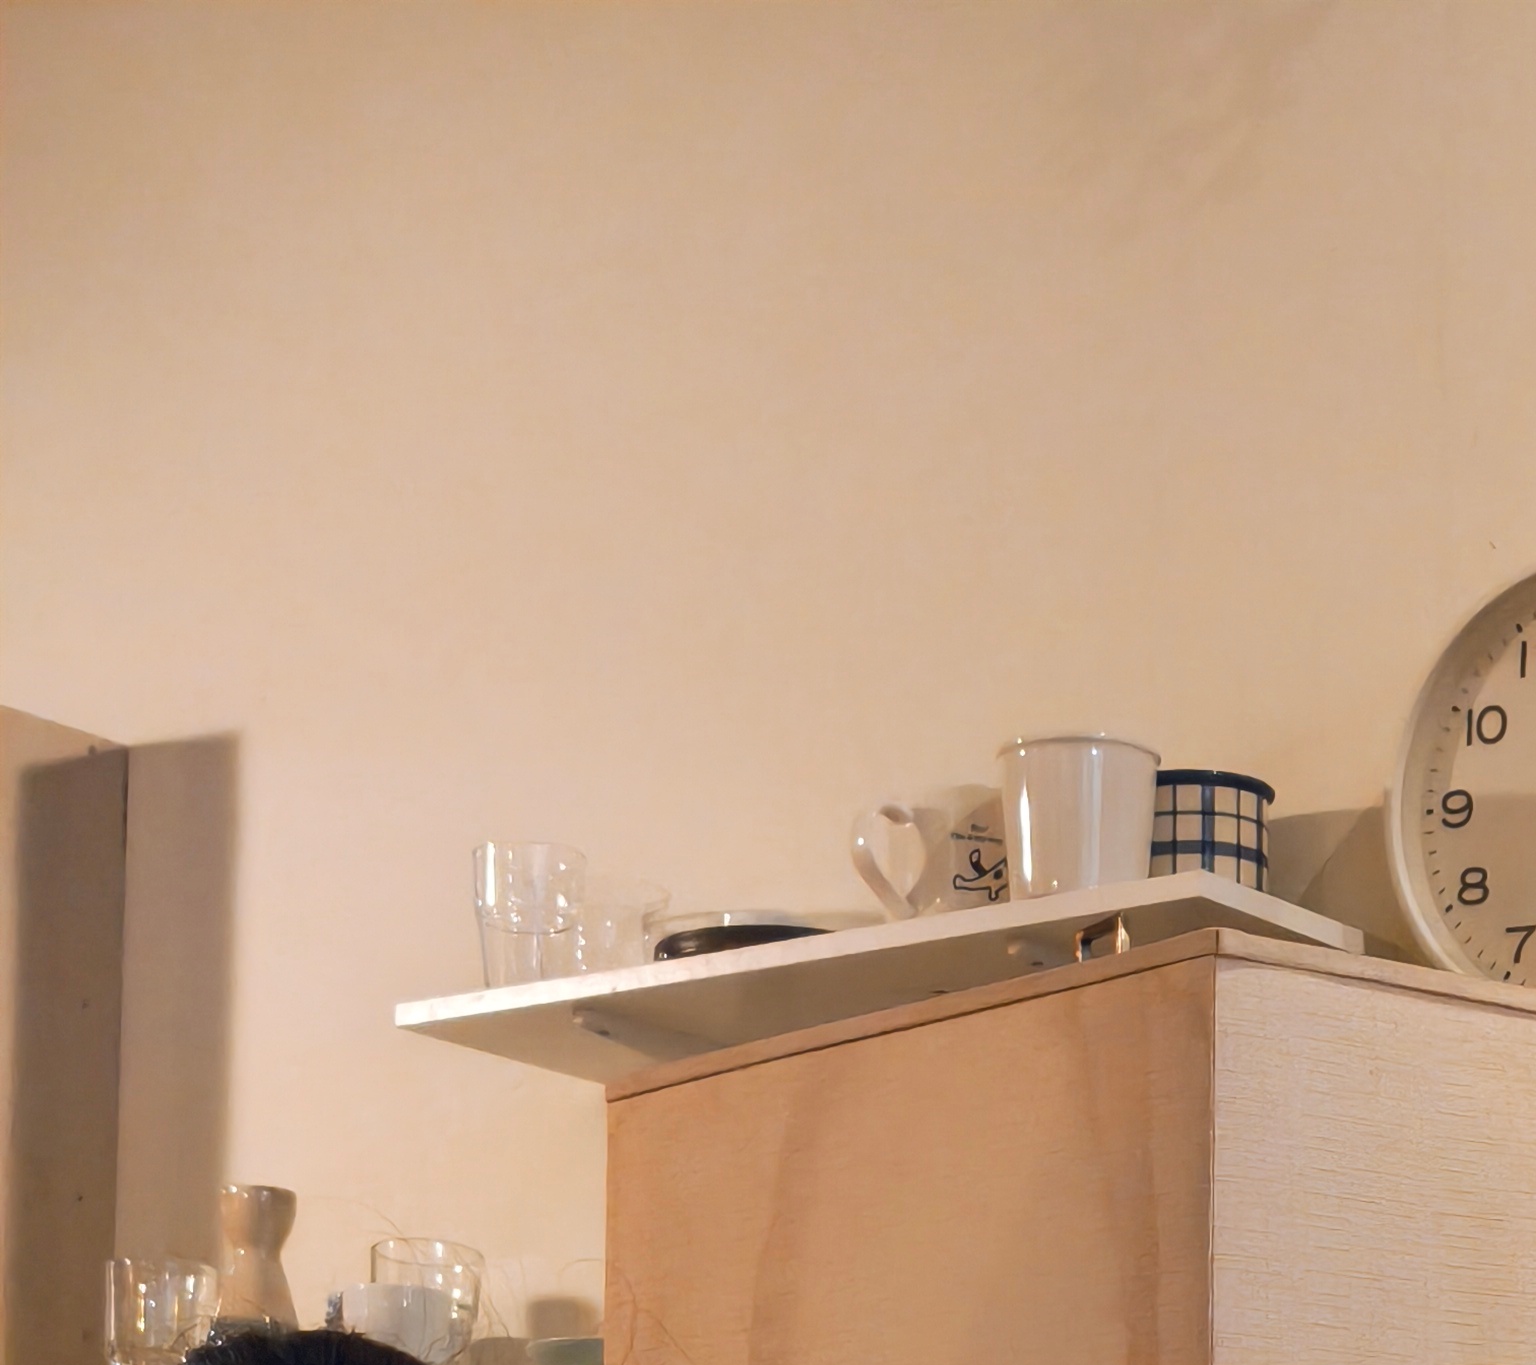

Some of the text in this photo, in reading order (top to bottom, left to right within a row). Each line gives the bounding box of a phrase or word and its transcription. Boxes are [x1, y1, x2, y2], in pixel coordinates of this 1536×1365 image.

[1466, 705, 1508, 747] 10
[1441, 789, 1474, 829] 9
[1457, 867, 1490, 905] 8
[1505, 925, 1536, 964] 7
